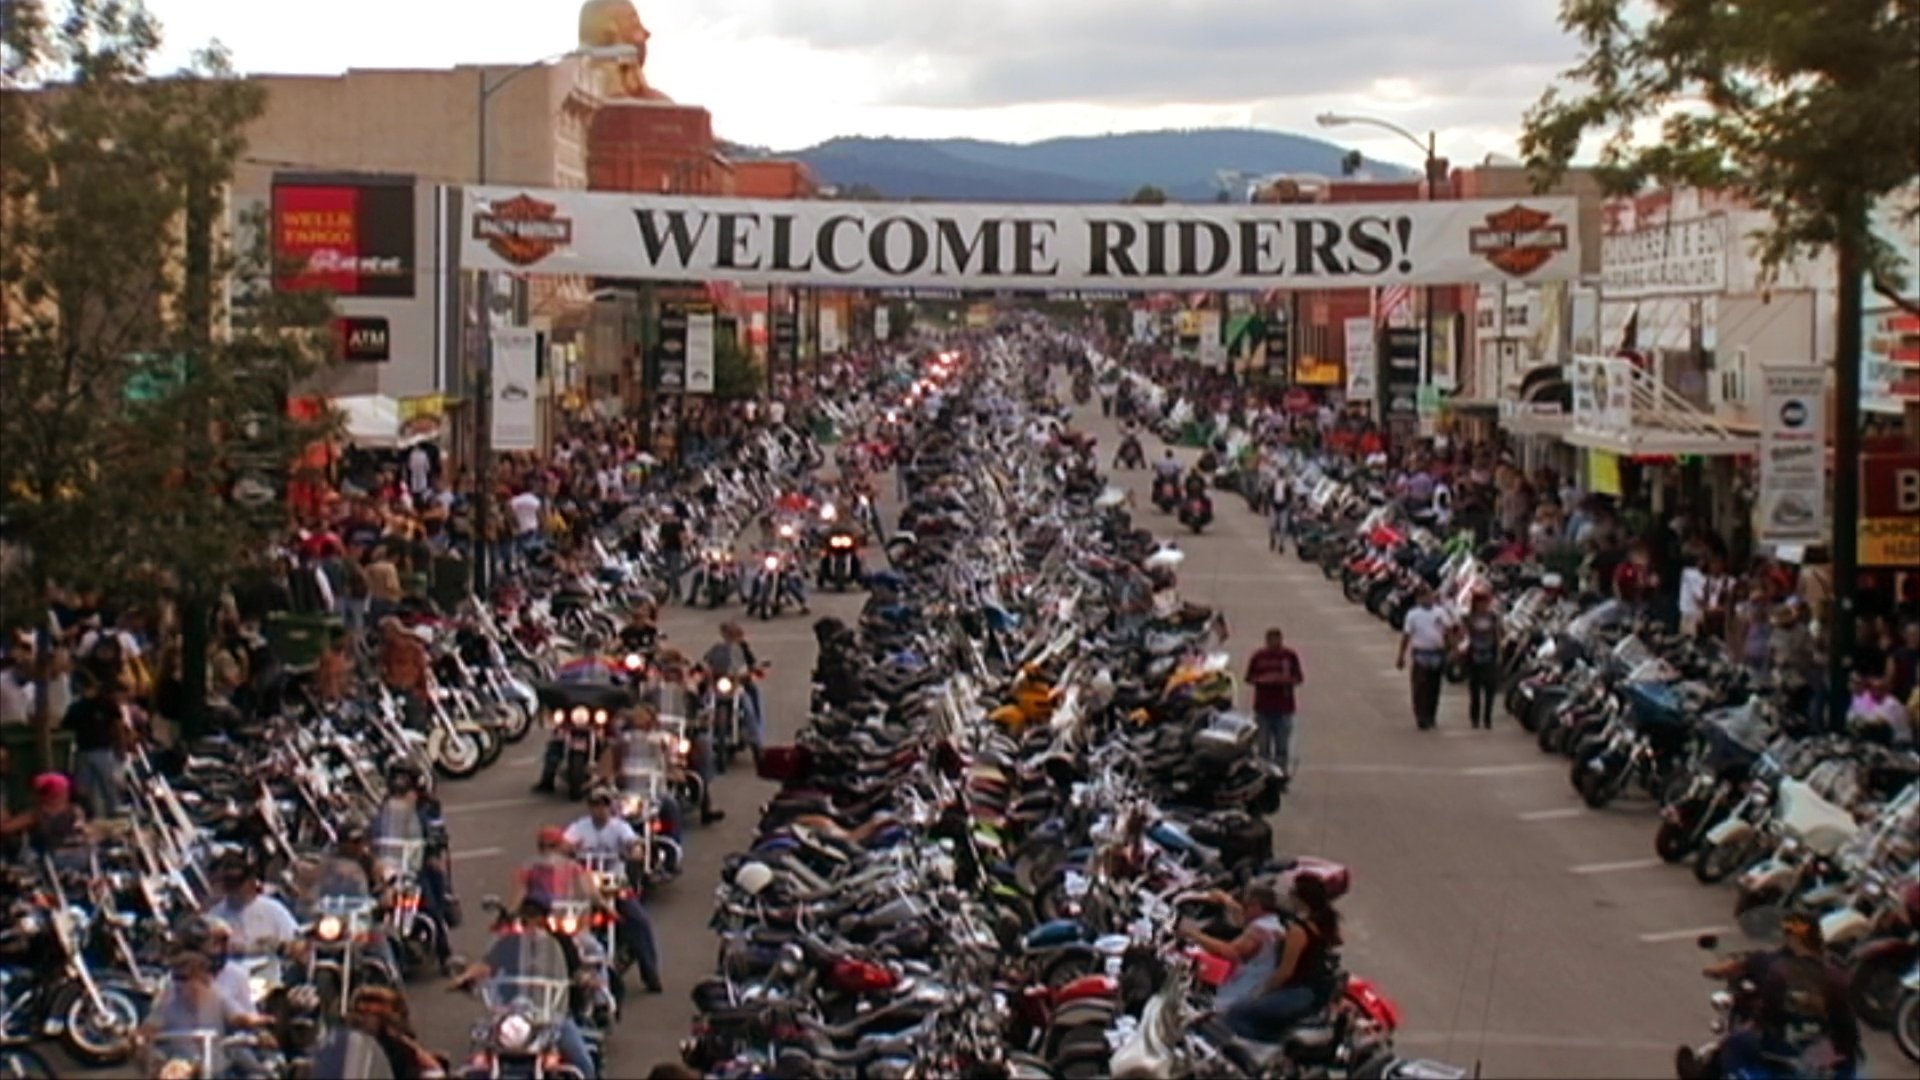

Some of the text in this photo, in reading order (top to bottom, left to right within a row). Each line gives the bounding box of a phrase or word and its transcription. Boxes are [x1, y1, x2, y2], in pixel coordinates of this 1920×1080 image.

[282, 211, 352, 227] WELLS
[284, 229, 351, 246] FARGO
[632, 207, 1413, 277] WELCOME RIDERS!
[349, 330, 385, 347] ATM
